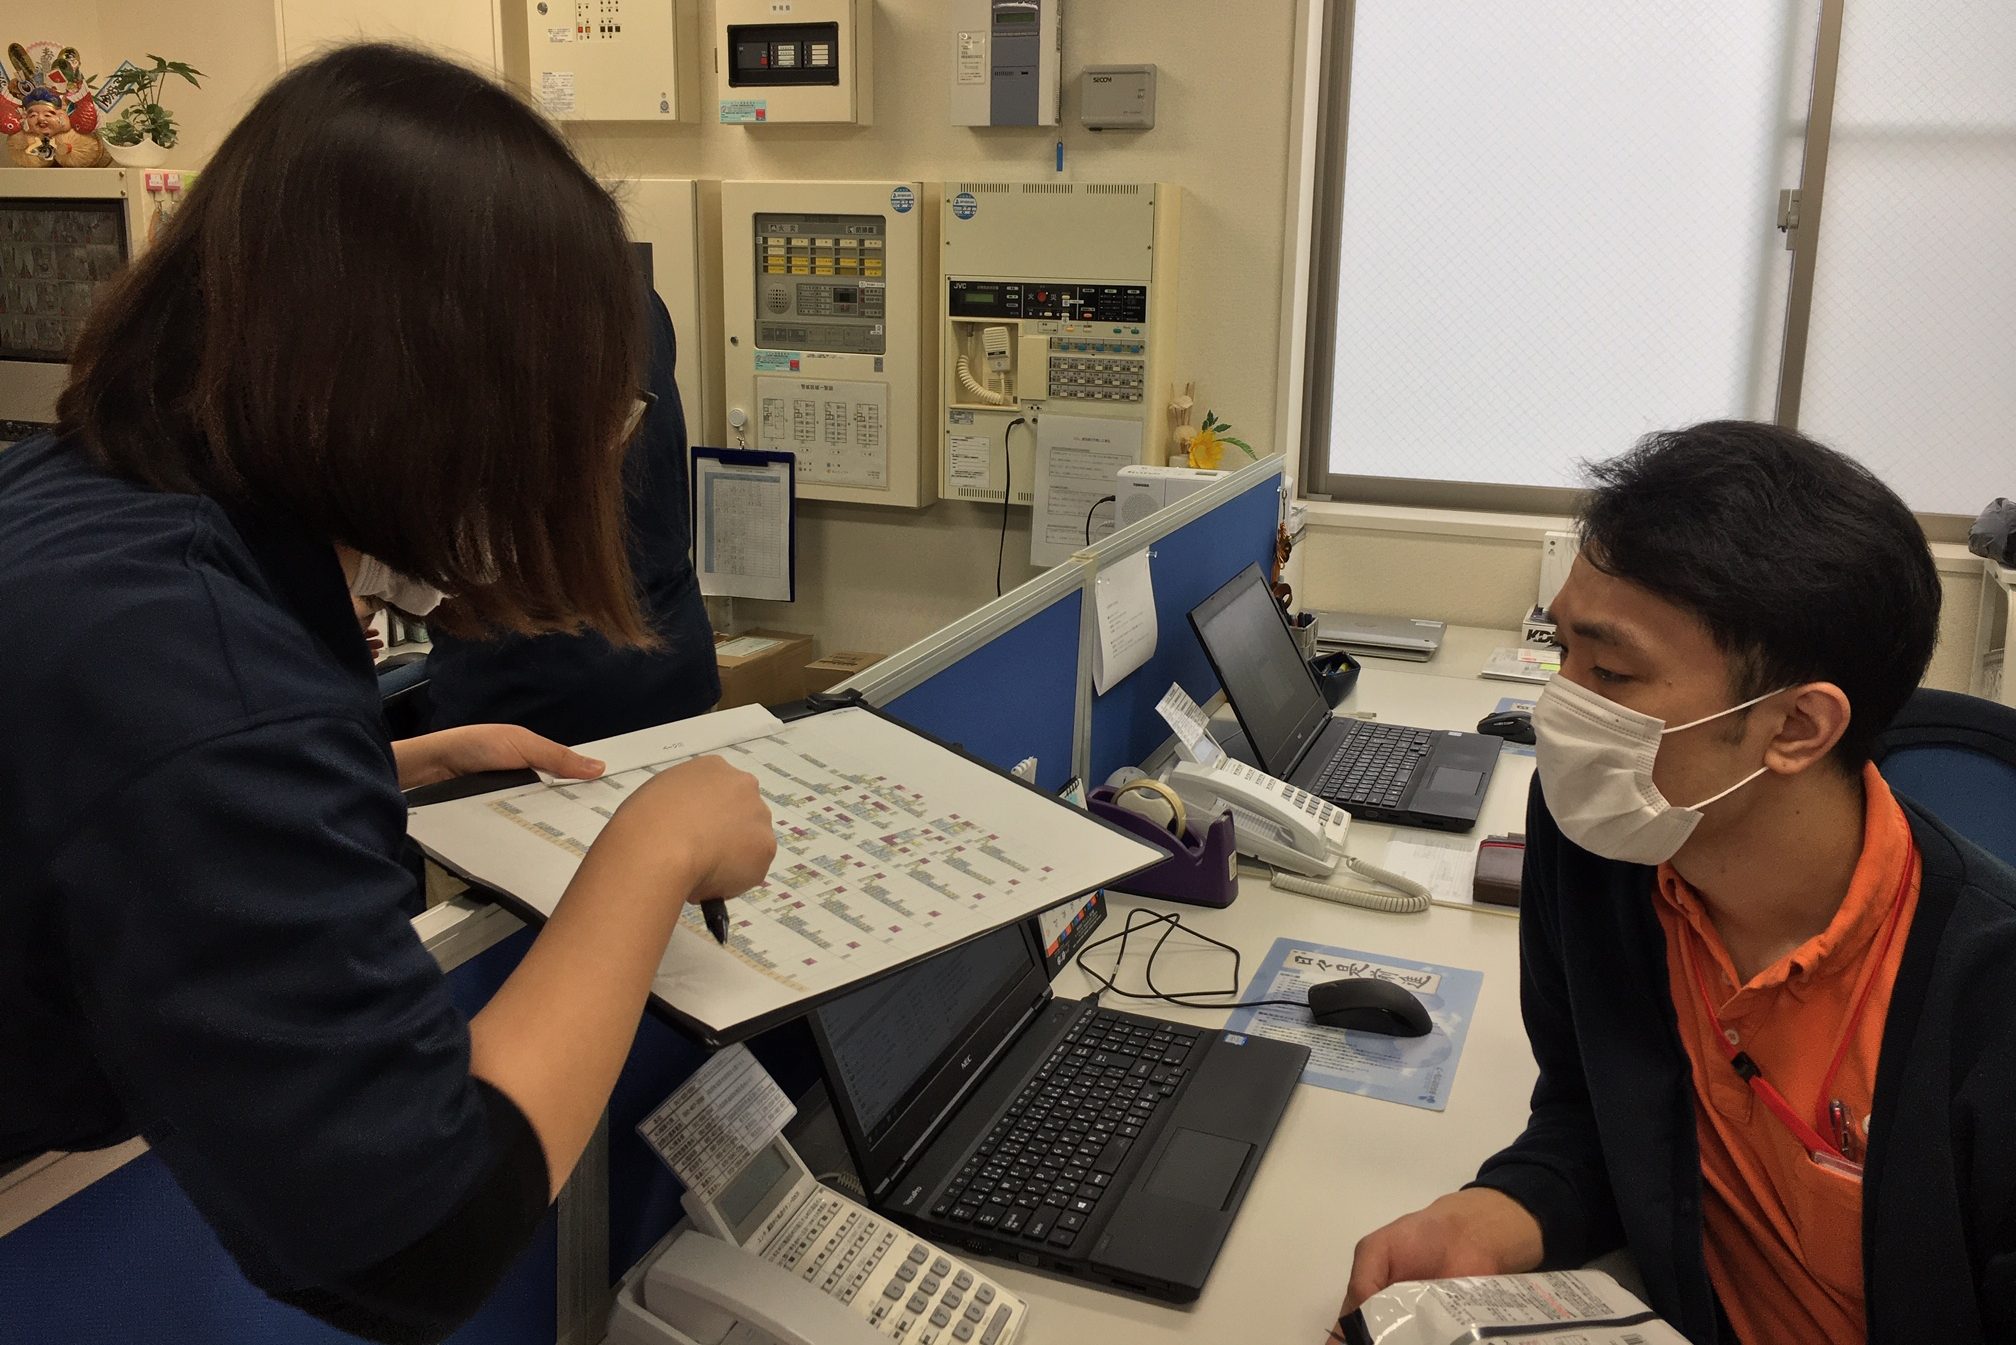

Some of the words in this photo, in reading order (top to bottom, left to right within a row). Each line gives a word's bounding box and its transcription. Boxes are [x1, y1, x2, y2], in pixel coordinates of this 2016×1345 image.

[1294, 955, 1432, 989] 日々是前進
[961, 1054, 972, 1069] NEC
